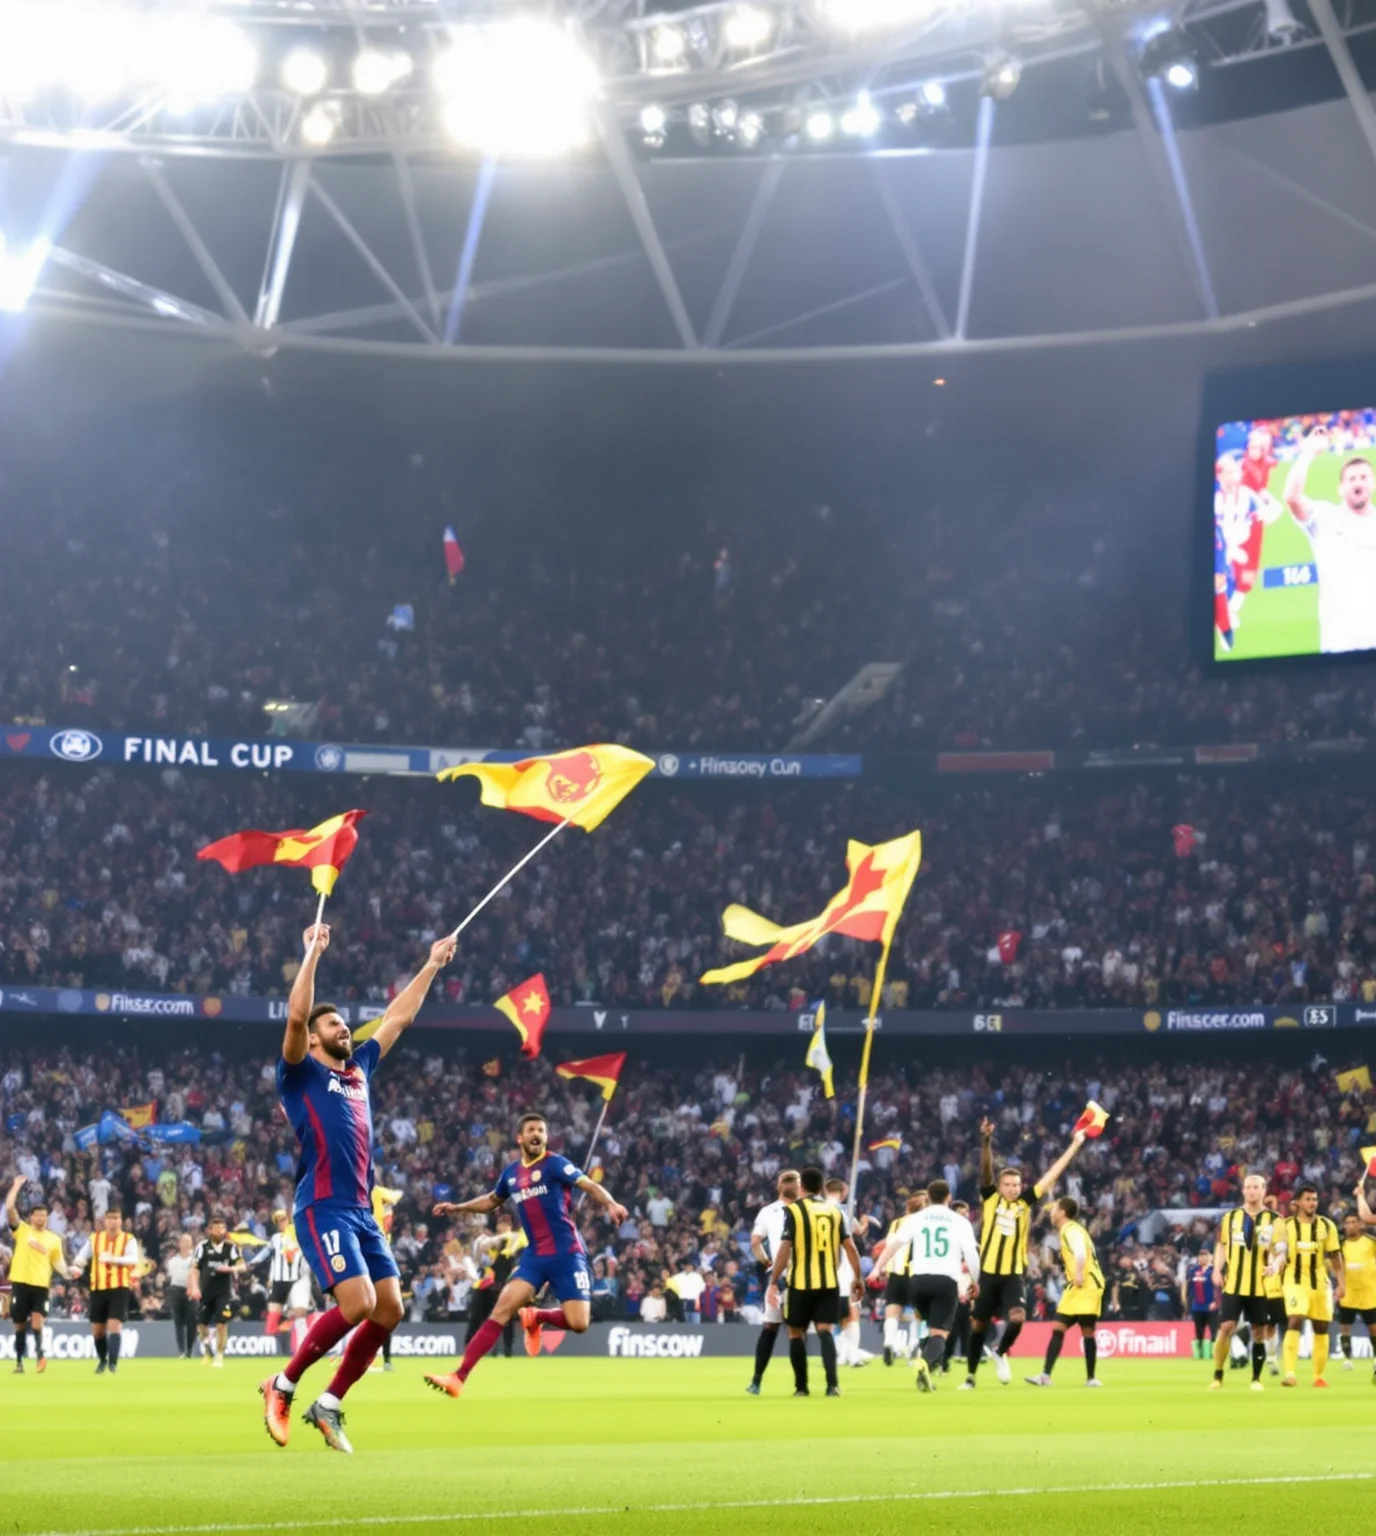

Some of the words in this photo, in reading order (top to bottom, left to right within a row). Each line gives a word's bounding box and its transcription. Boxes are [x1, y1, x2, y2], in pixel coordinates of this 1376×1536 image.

[124, 737, 218, 767] FINAL
[230, 742, 294, 768] CUP
[921, 1226, 950, 1259] 15
[608, 1326, 704, 1358] finscow
